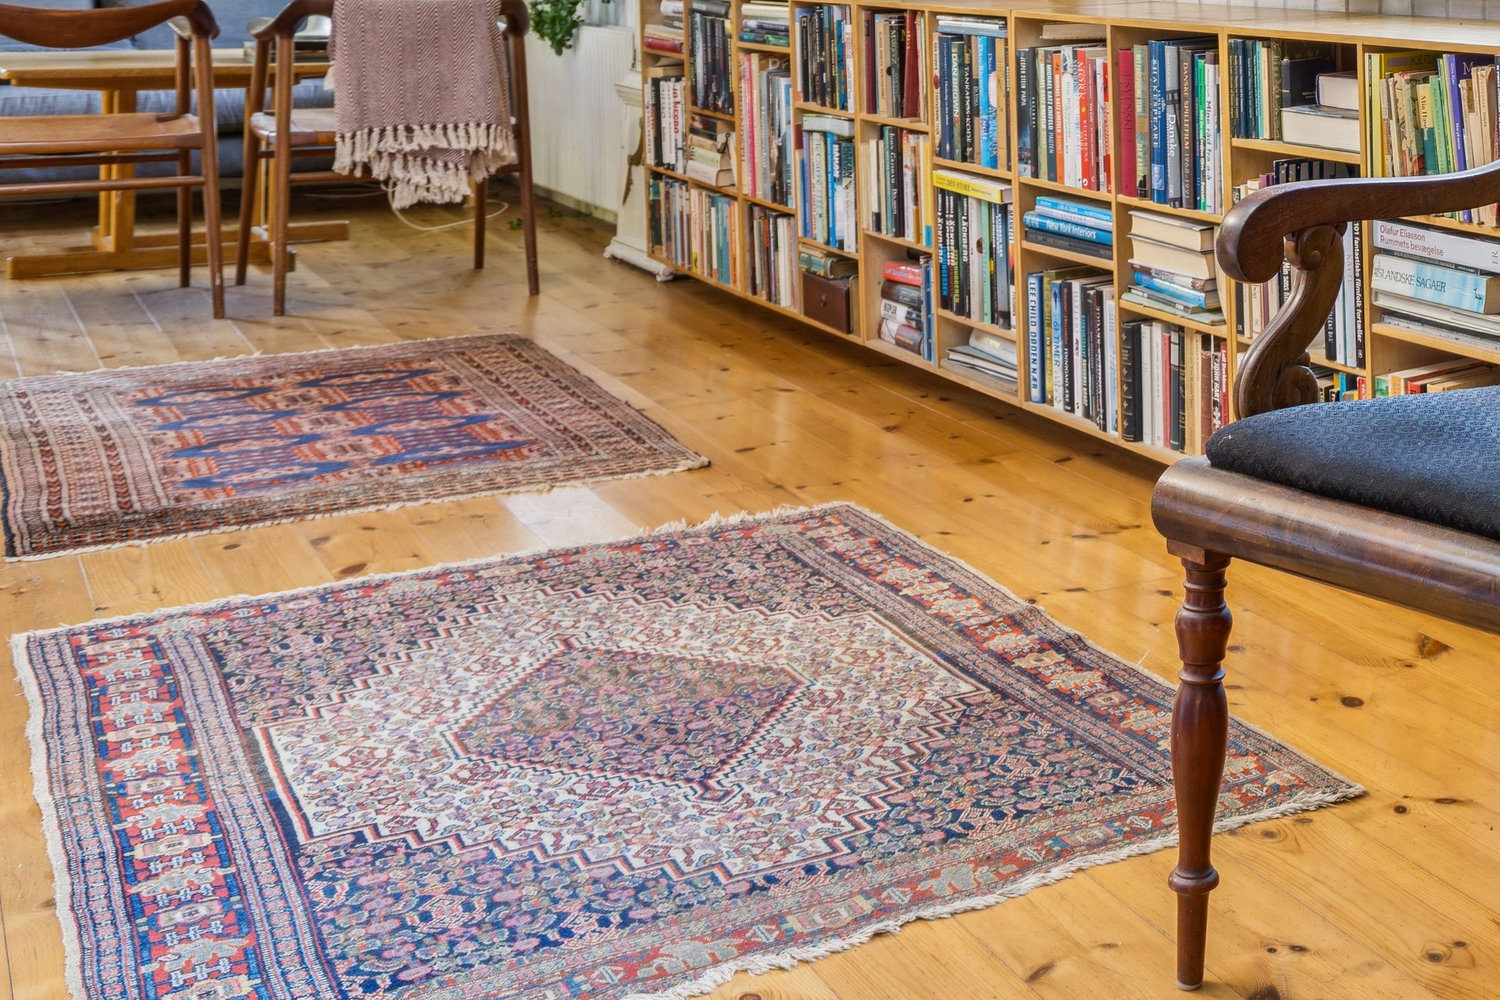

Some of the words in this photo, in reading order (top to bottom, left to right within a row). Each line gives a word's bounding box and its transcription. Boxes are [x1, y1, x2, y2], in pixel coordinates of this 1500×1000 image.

[952, 78, 960, 118] BROWN
[1168, 114, 1177, 157] Danske
[1046, 218, 1059, 230] New
[1059, 220, 1073, 234] York
[1072, 223, 1097, 240] Interiors
[1379, 225, 1399, 237] Olafur
[1400, 229, 1426, 242] Eliasson
[1379, 234, 1409, 249] Rummets
[1410, 240, 1444, 256] bevægelse
[1374, 261, 1415, 285] ISLANDSKE
[1416, 276, 1446, 293] SAGAER
[1053, 335, 1061, 366] TIMER
